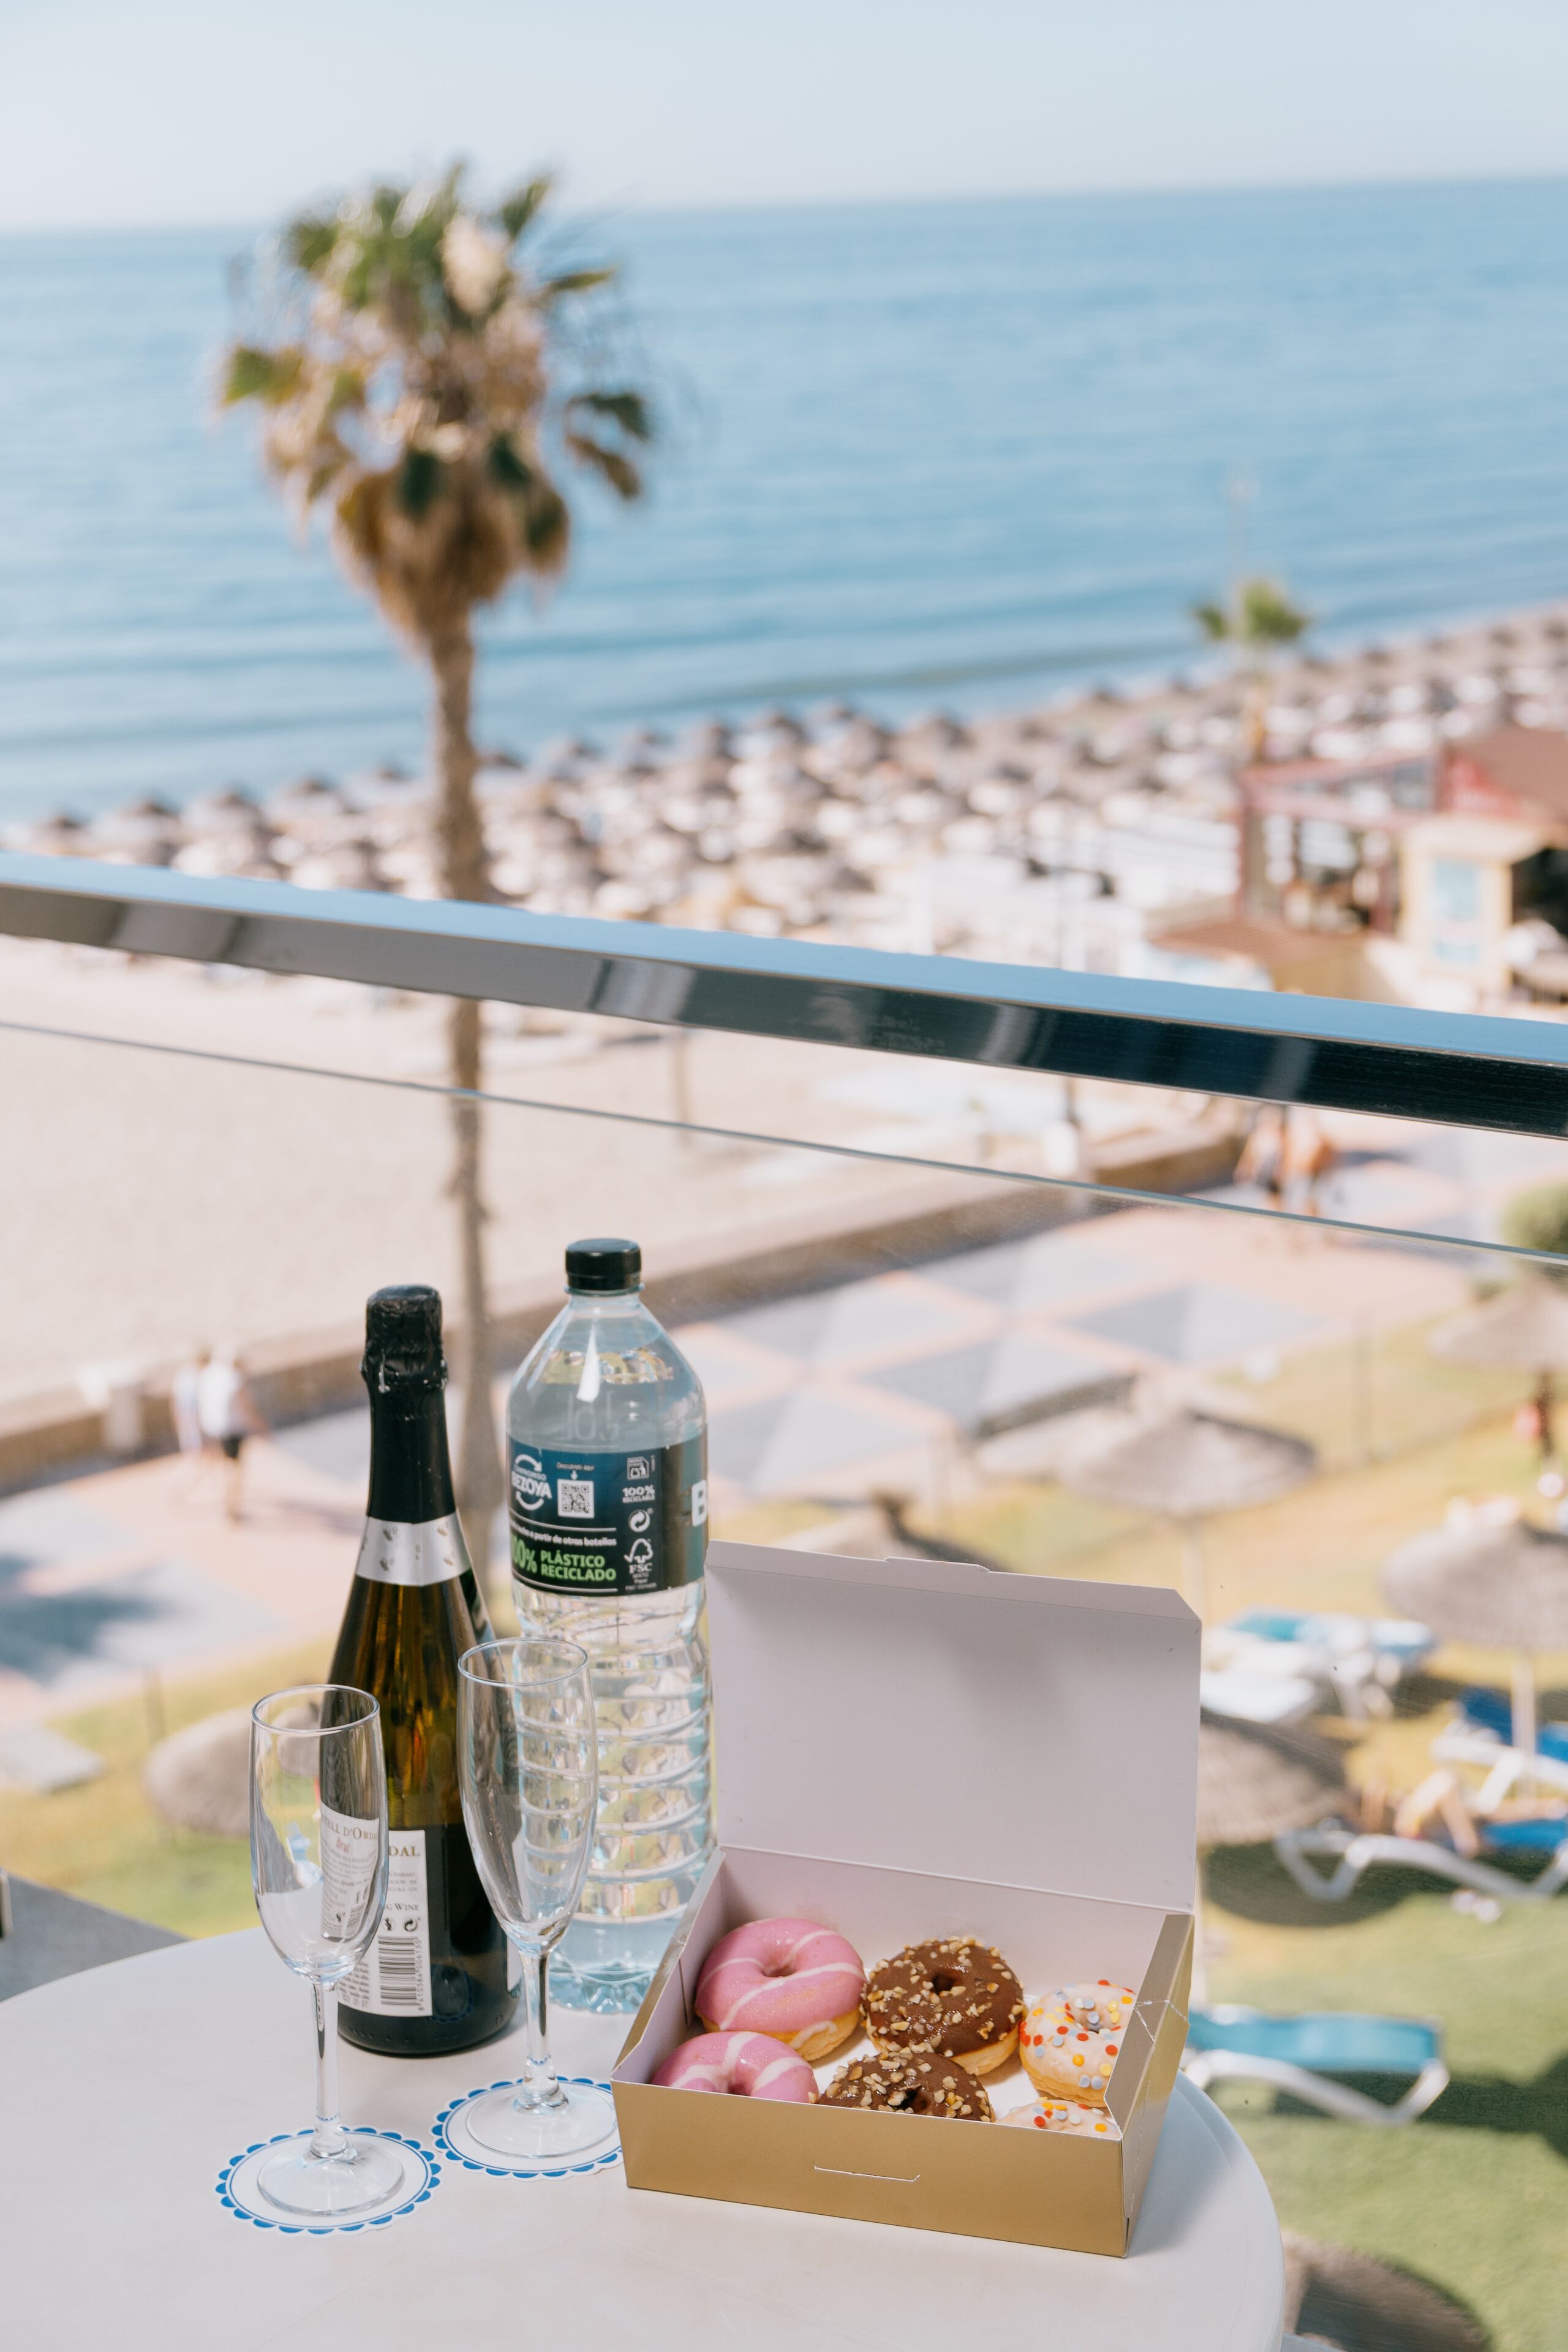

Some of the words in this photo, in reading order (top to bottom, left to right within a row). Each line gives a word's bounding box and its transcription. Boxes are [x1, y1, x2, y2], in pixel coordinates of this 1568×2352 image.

[622, 1485, 655, 1497] 100%
[534, 1532, 552, 1542] partir
[552, 1534, 562, 1544] de
[562, 1537, 583, 1545] otras
[584, 1537, 617, 1546] botellas
[540, 1549, 606, 1568] PLÁSTICO
[540, 1563, 617, 1581] RECICLADO
[629, 1562, 653, 1574] FSC
